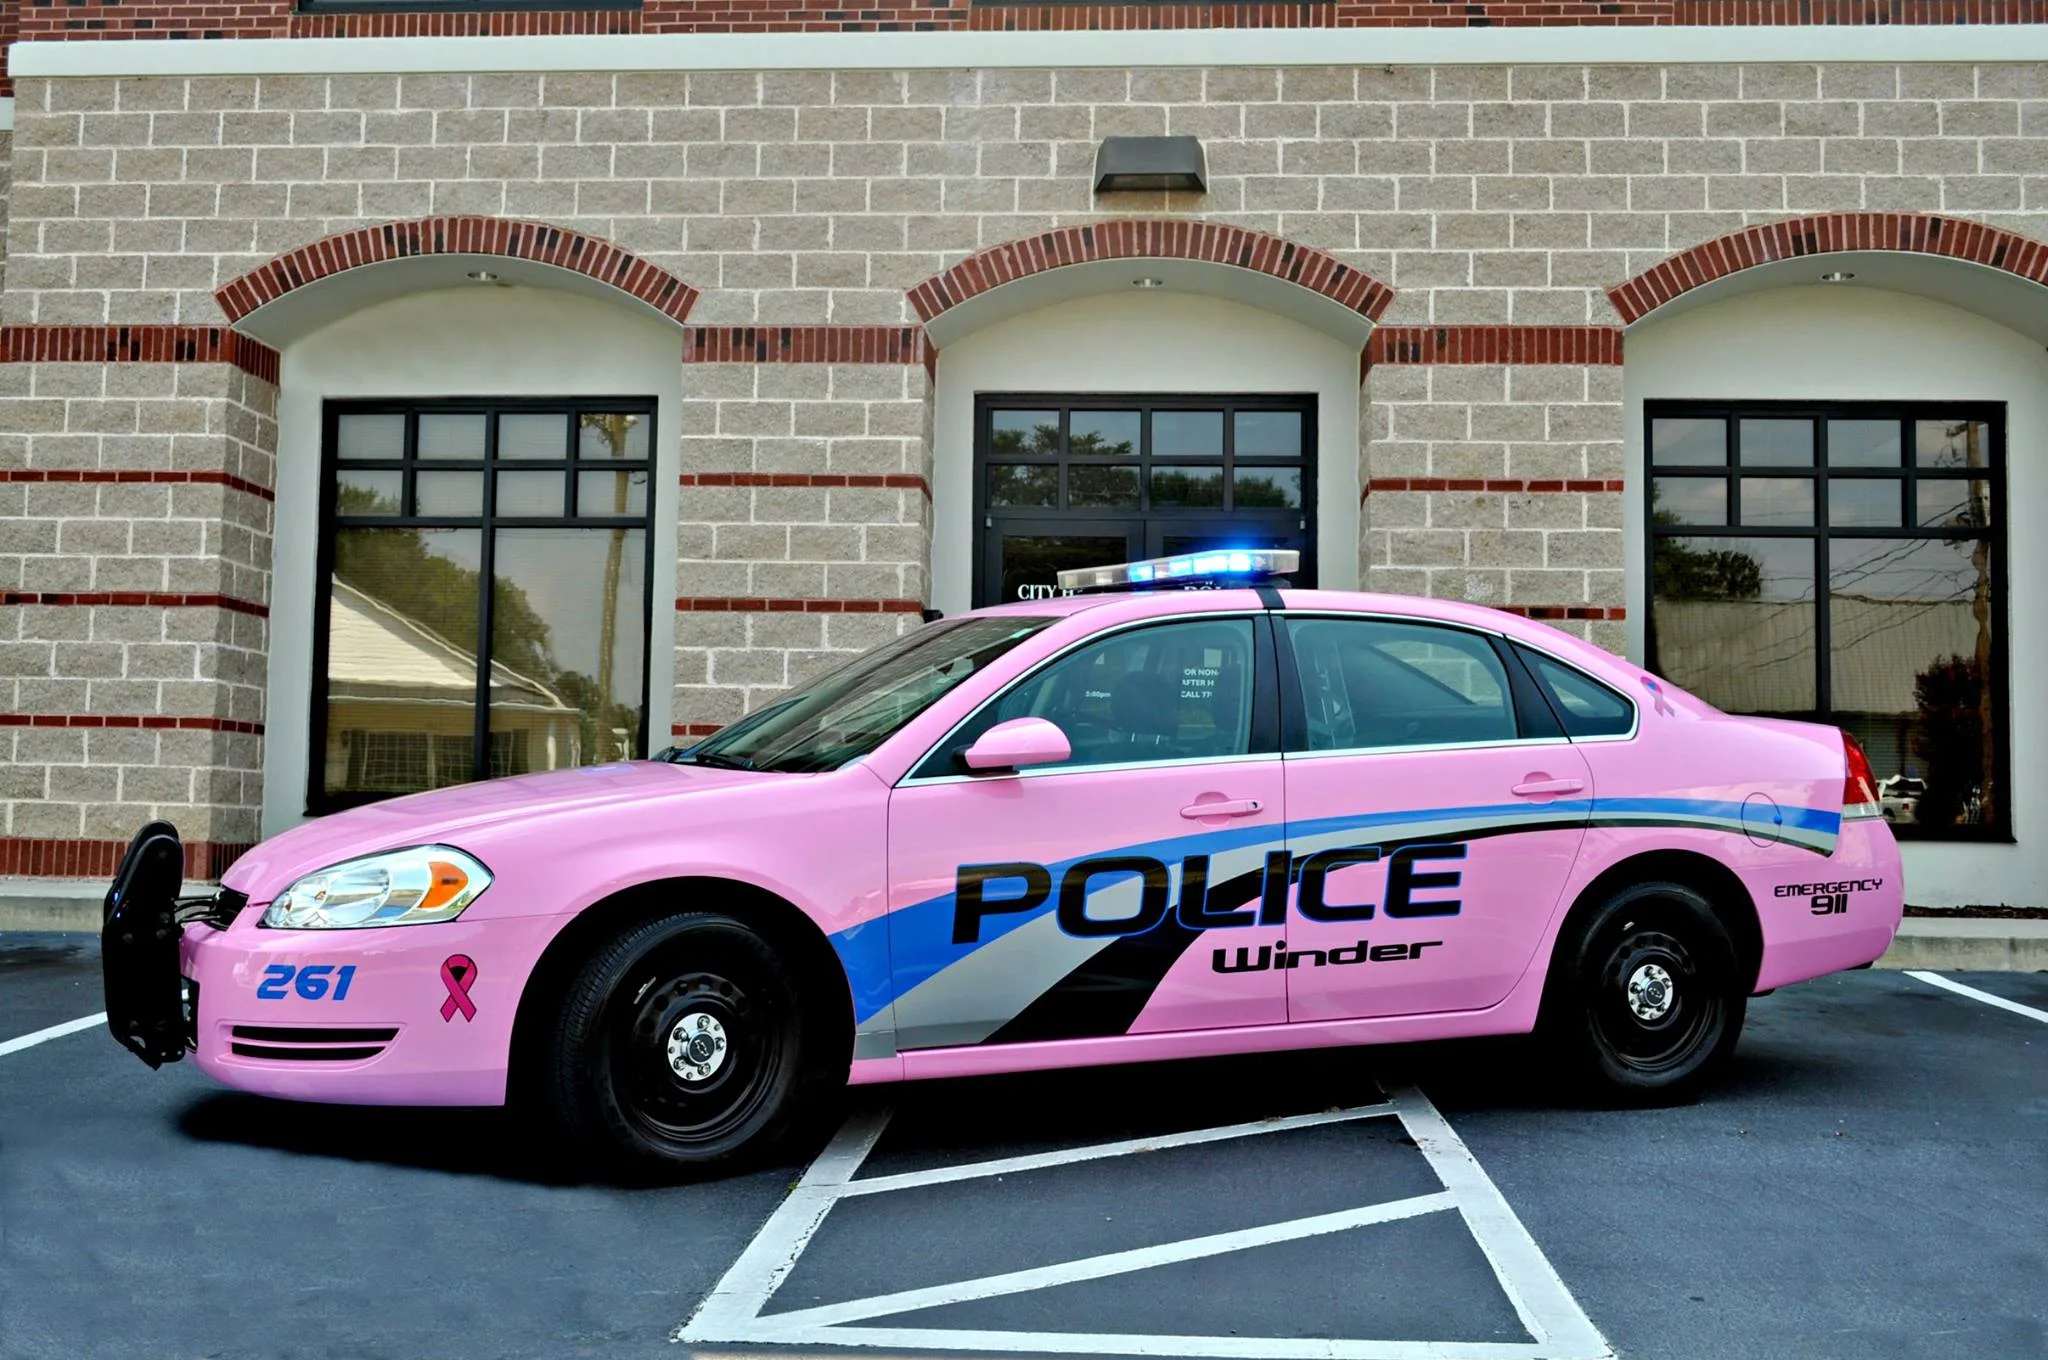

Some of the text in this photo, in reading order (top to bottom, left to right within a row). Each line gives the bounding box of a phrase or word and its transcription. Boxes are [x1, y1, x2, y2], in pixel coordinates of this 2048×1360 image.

[1017, 584, 1057, 600] CITY
[951, 844, 1467, 944] POLICE
[1774, 878, 1883, 897] EMERGENCY
[1811, 893, 1848, 916] 911
[1212, 940, 1443, 973] Winder
[256, 964, 357, 1001] 261
